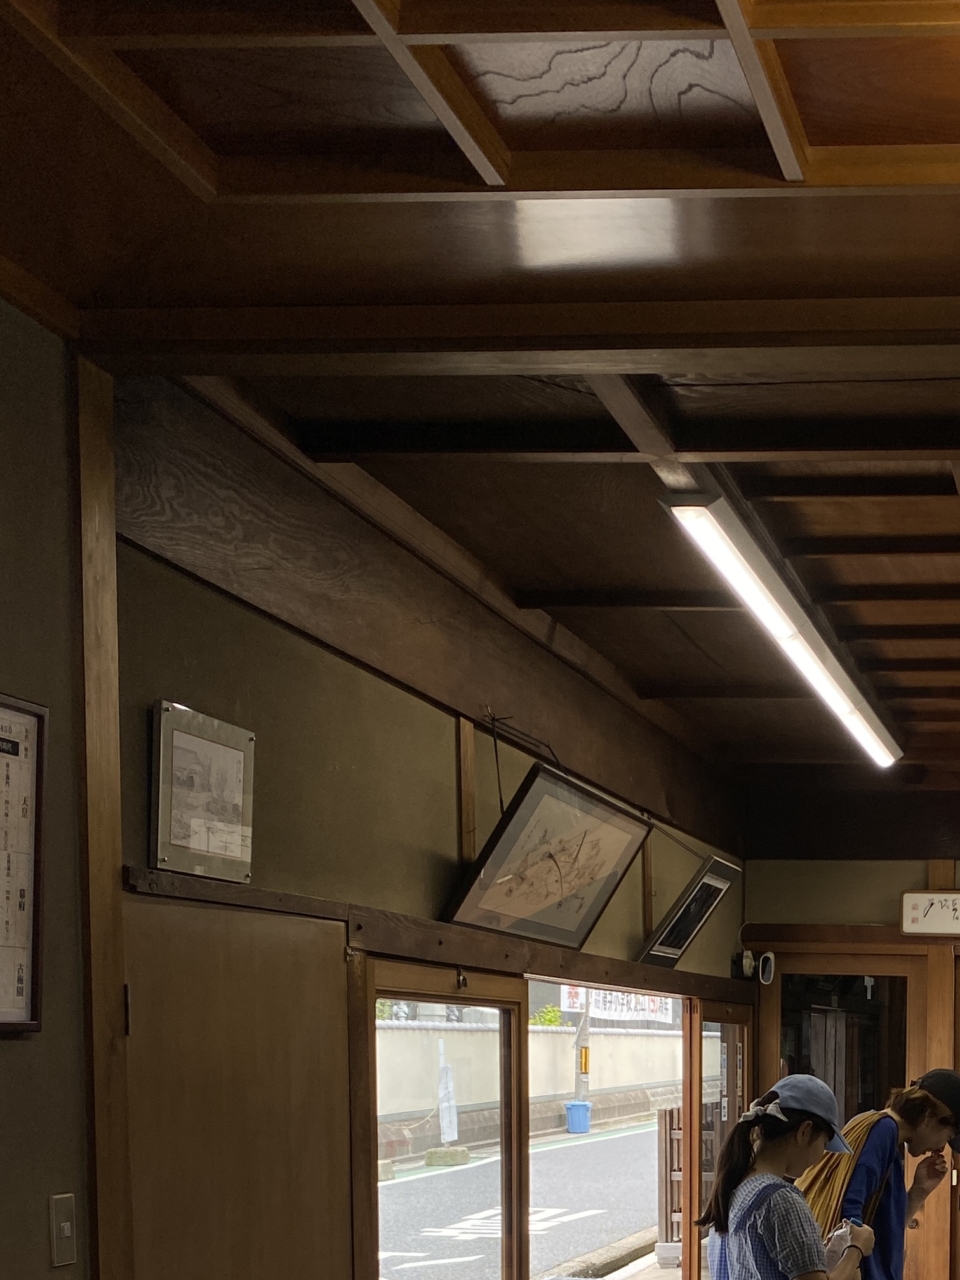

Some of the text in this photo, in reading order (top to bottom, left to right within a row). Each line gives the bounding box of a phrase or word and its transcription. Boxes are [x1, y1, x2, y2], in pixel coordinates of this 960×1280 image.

[20, 795, 28, 819] 天皇
[16, 962, 24, 998] 古梅園
